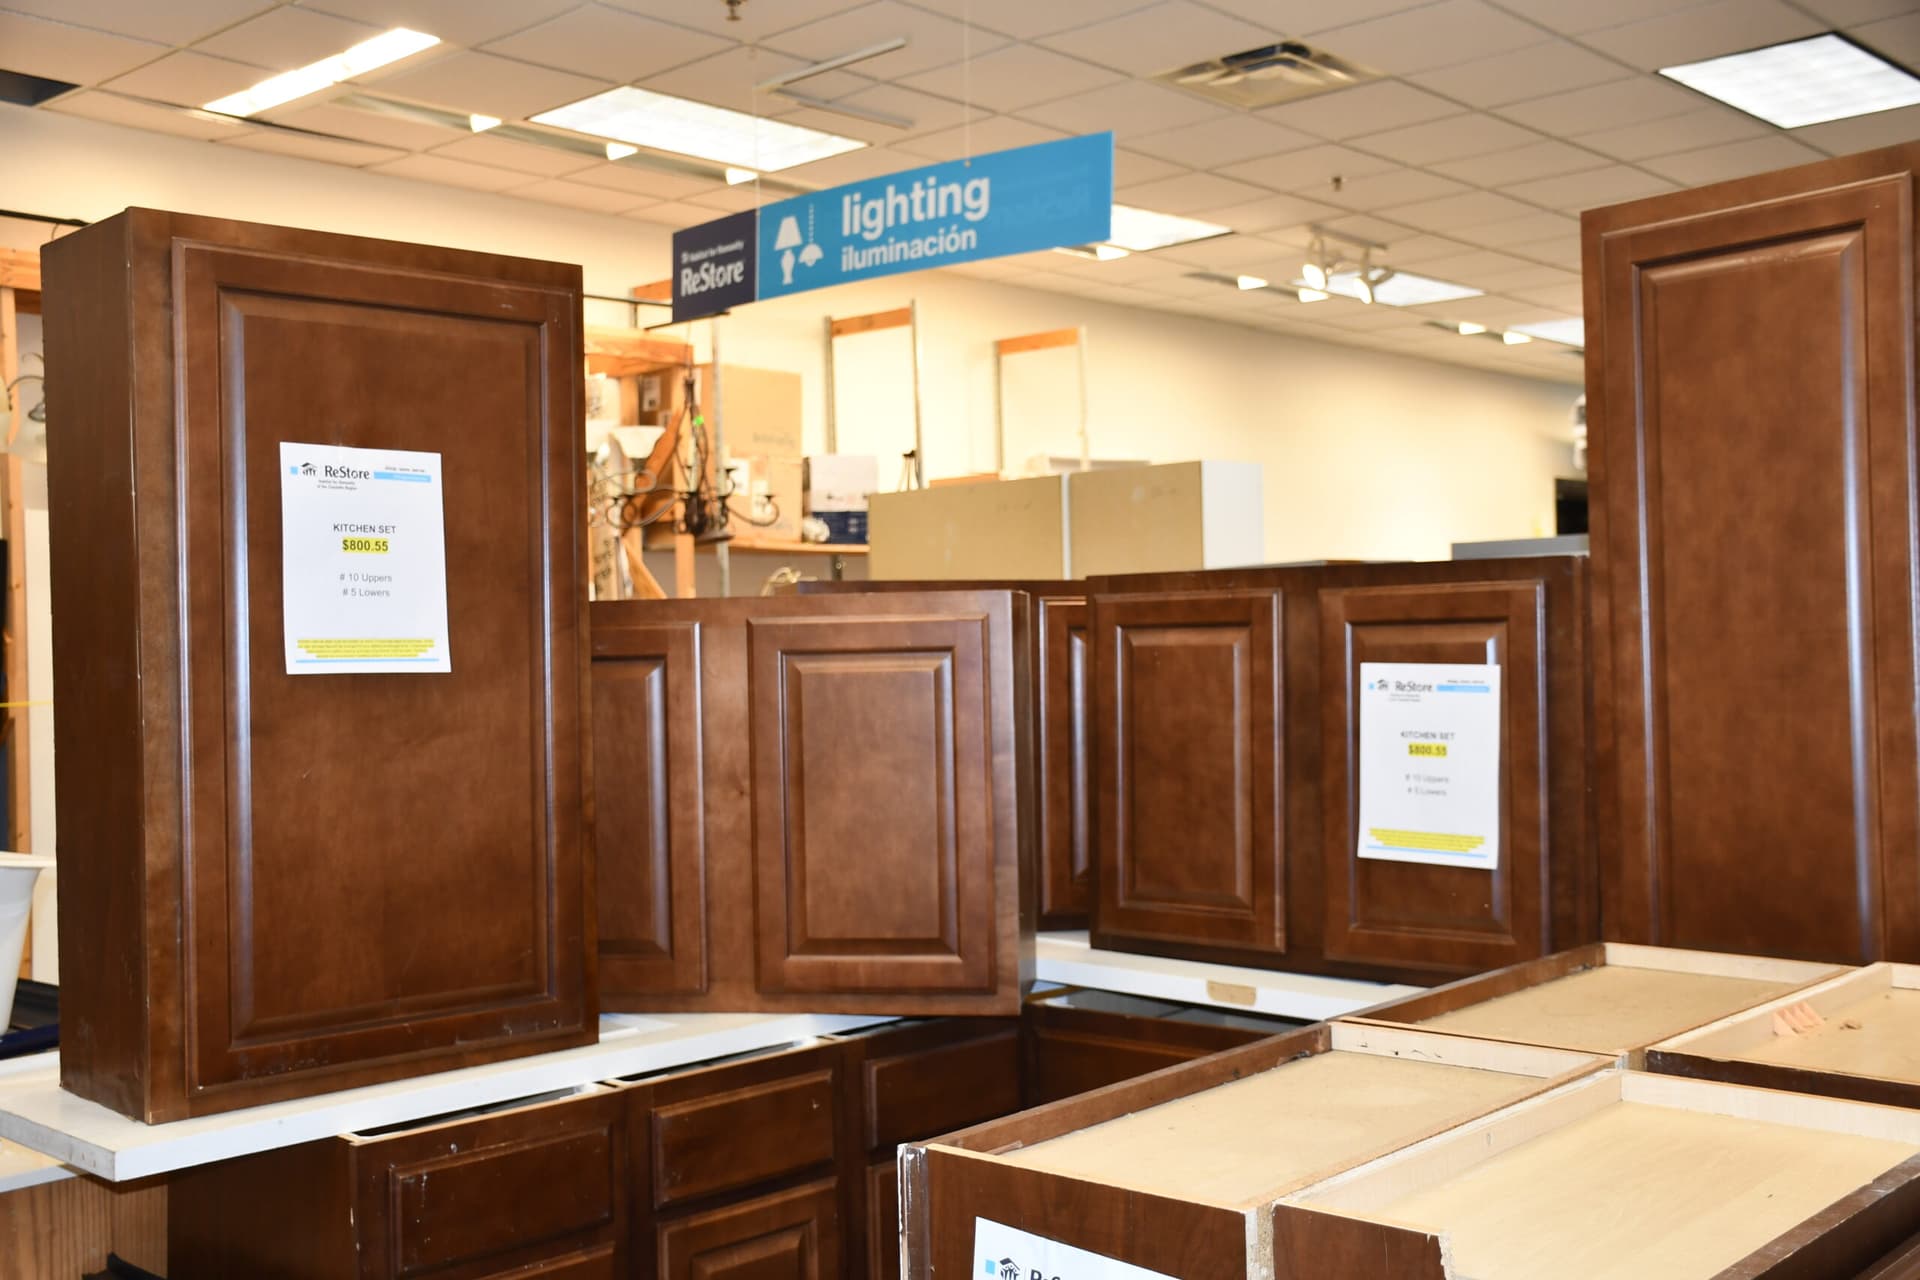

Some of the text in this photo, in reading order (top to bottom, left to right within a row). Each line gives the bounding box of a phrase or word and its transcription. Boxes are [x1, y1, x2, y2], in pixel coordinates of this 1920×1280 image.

[842, 176, 990, 241] lighting
[841, 224, 978, 272] iluminación
[681, 260, 745, 297] ReStore
[324, 465, 370, 480] ReStore
[333, 523, 397, 534] KITCHEN SET
[342, 539, 389, 552] $800.55
[339, 573, 393, 583] # 10 Uppers
[350, 588, 357, 597] 5
[359, 588, 391, 597] Lowers
